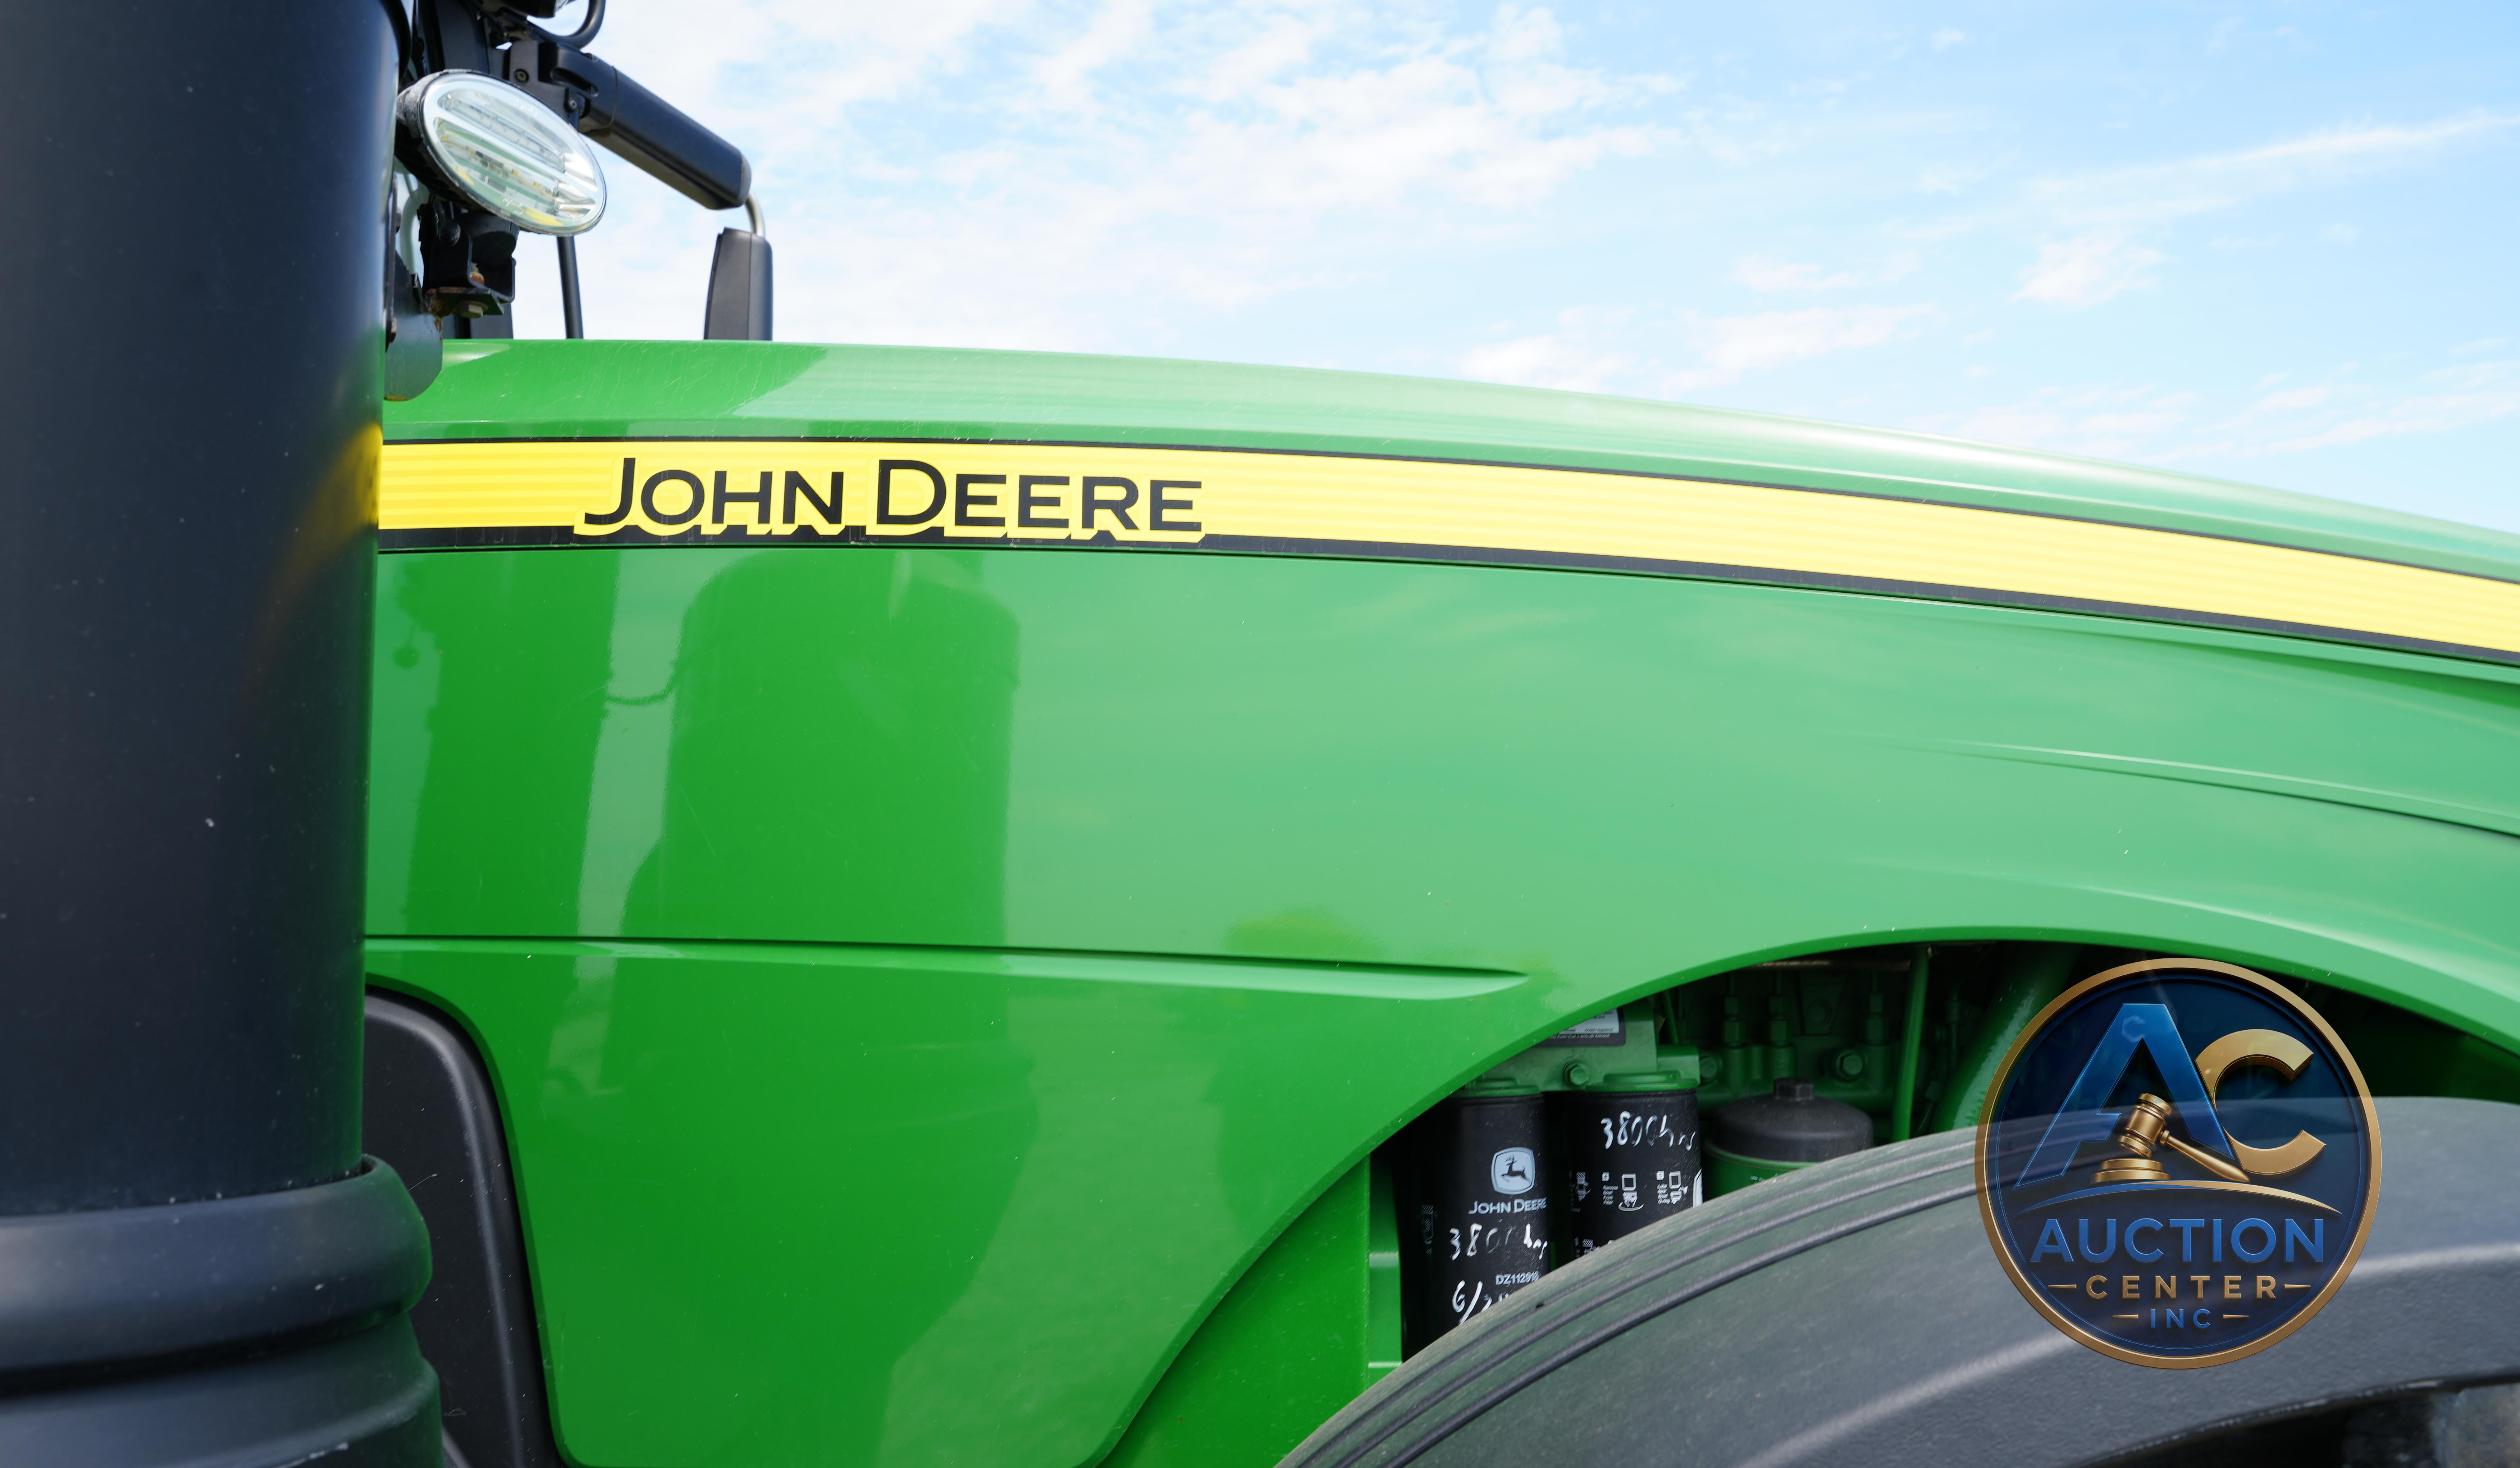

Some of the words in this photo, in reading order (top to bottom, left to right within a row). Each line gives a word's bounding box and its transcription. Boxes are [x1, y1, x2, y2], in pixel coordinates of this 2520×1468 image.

[585, 457, 843, 525] JOHN
[878, 460, 1202, 532] DEERE
[1469, 1201, 1511, 1214] JOHN
[1514, 1198, 1547, 1213] DEERE
